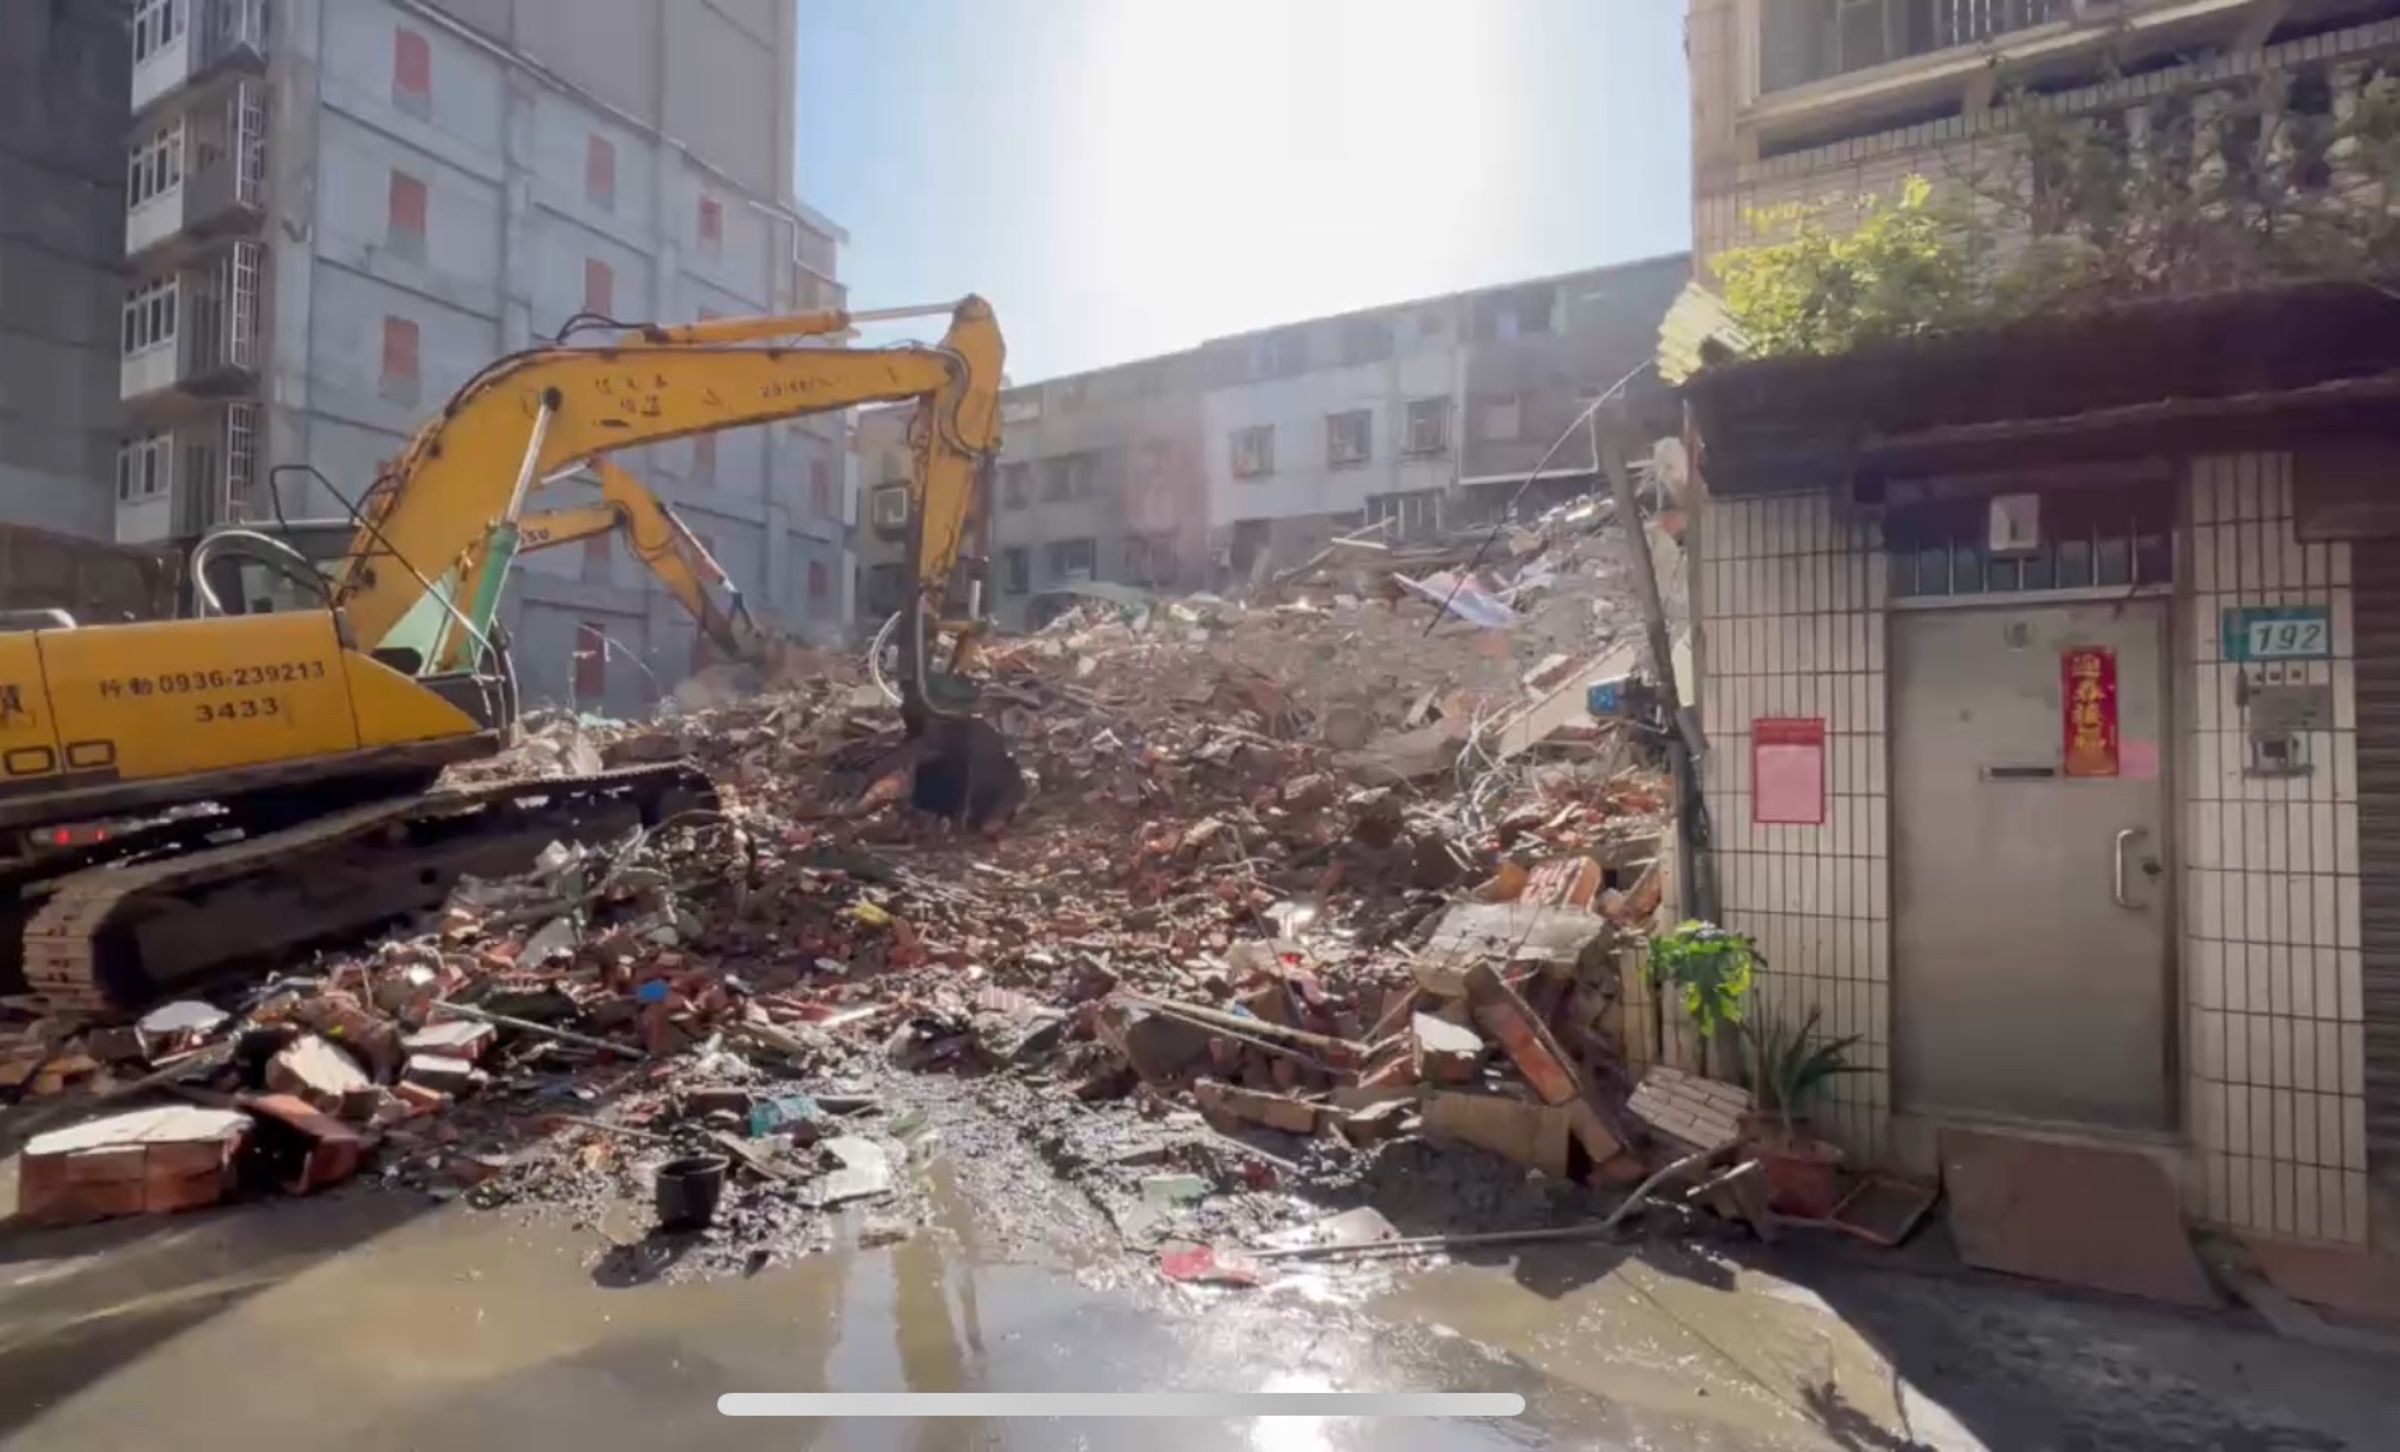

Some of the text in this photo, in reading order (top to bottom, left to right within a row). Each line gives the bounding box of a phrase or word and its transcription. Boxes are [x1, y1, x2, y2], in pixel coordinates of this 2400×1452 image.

[2256, 623, 2321, 652] 192
[159, 660, 326, 694] 0936-239213
[195, 697, 280, 723] 3433
